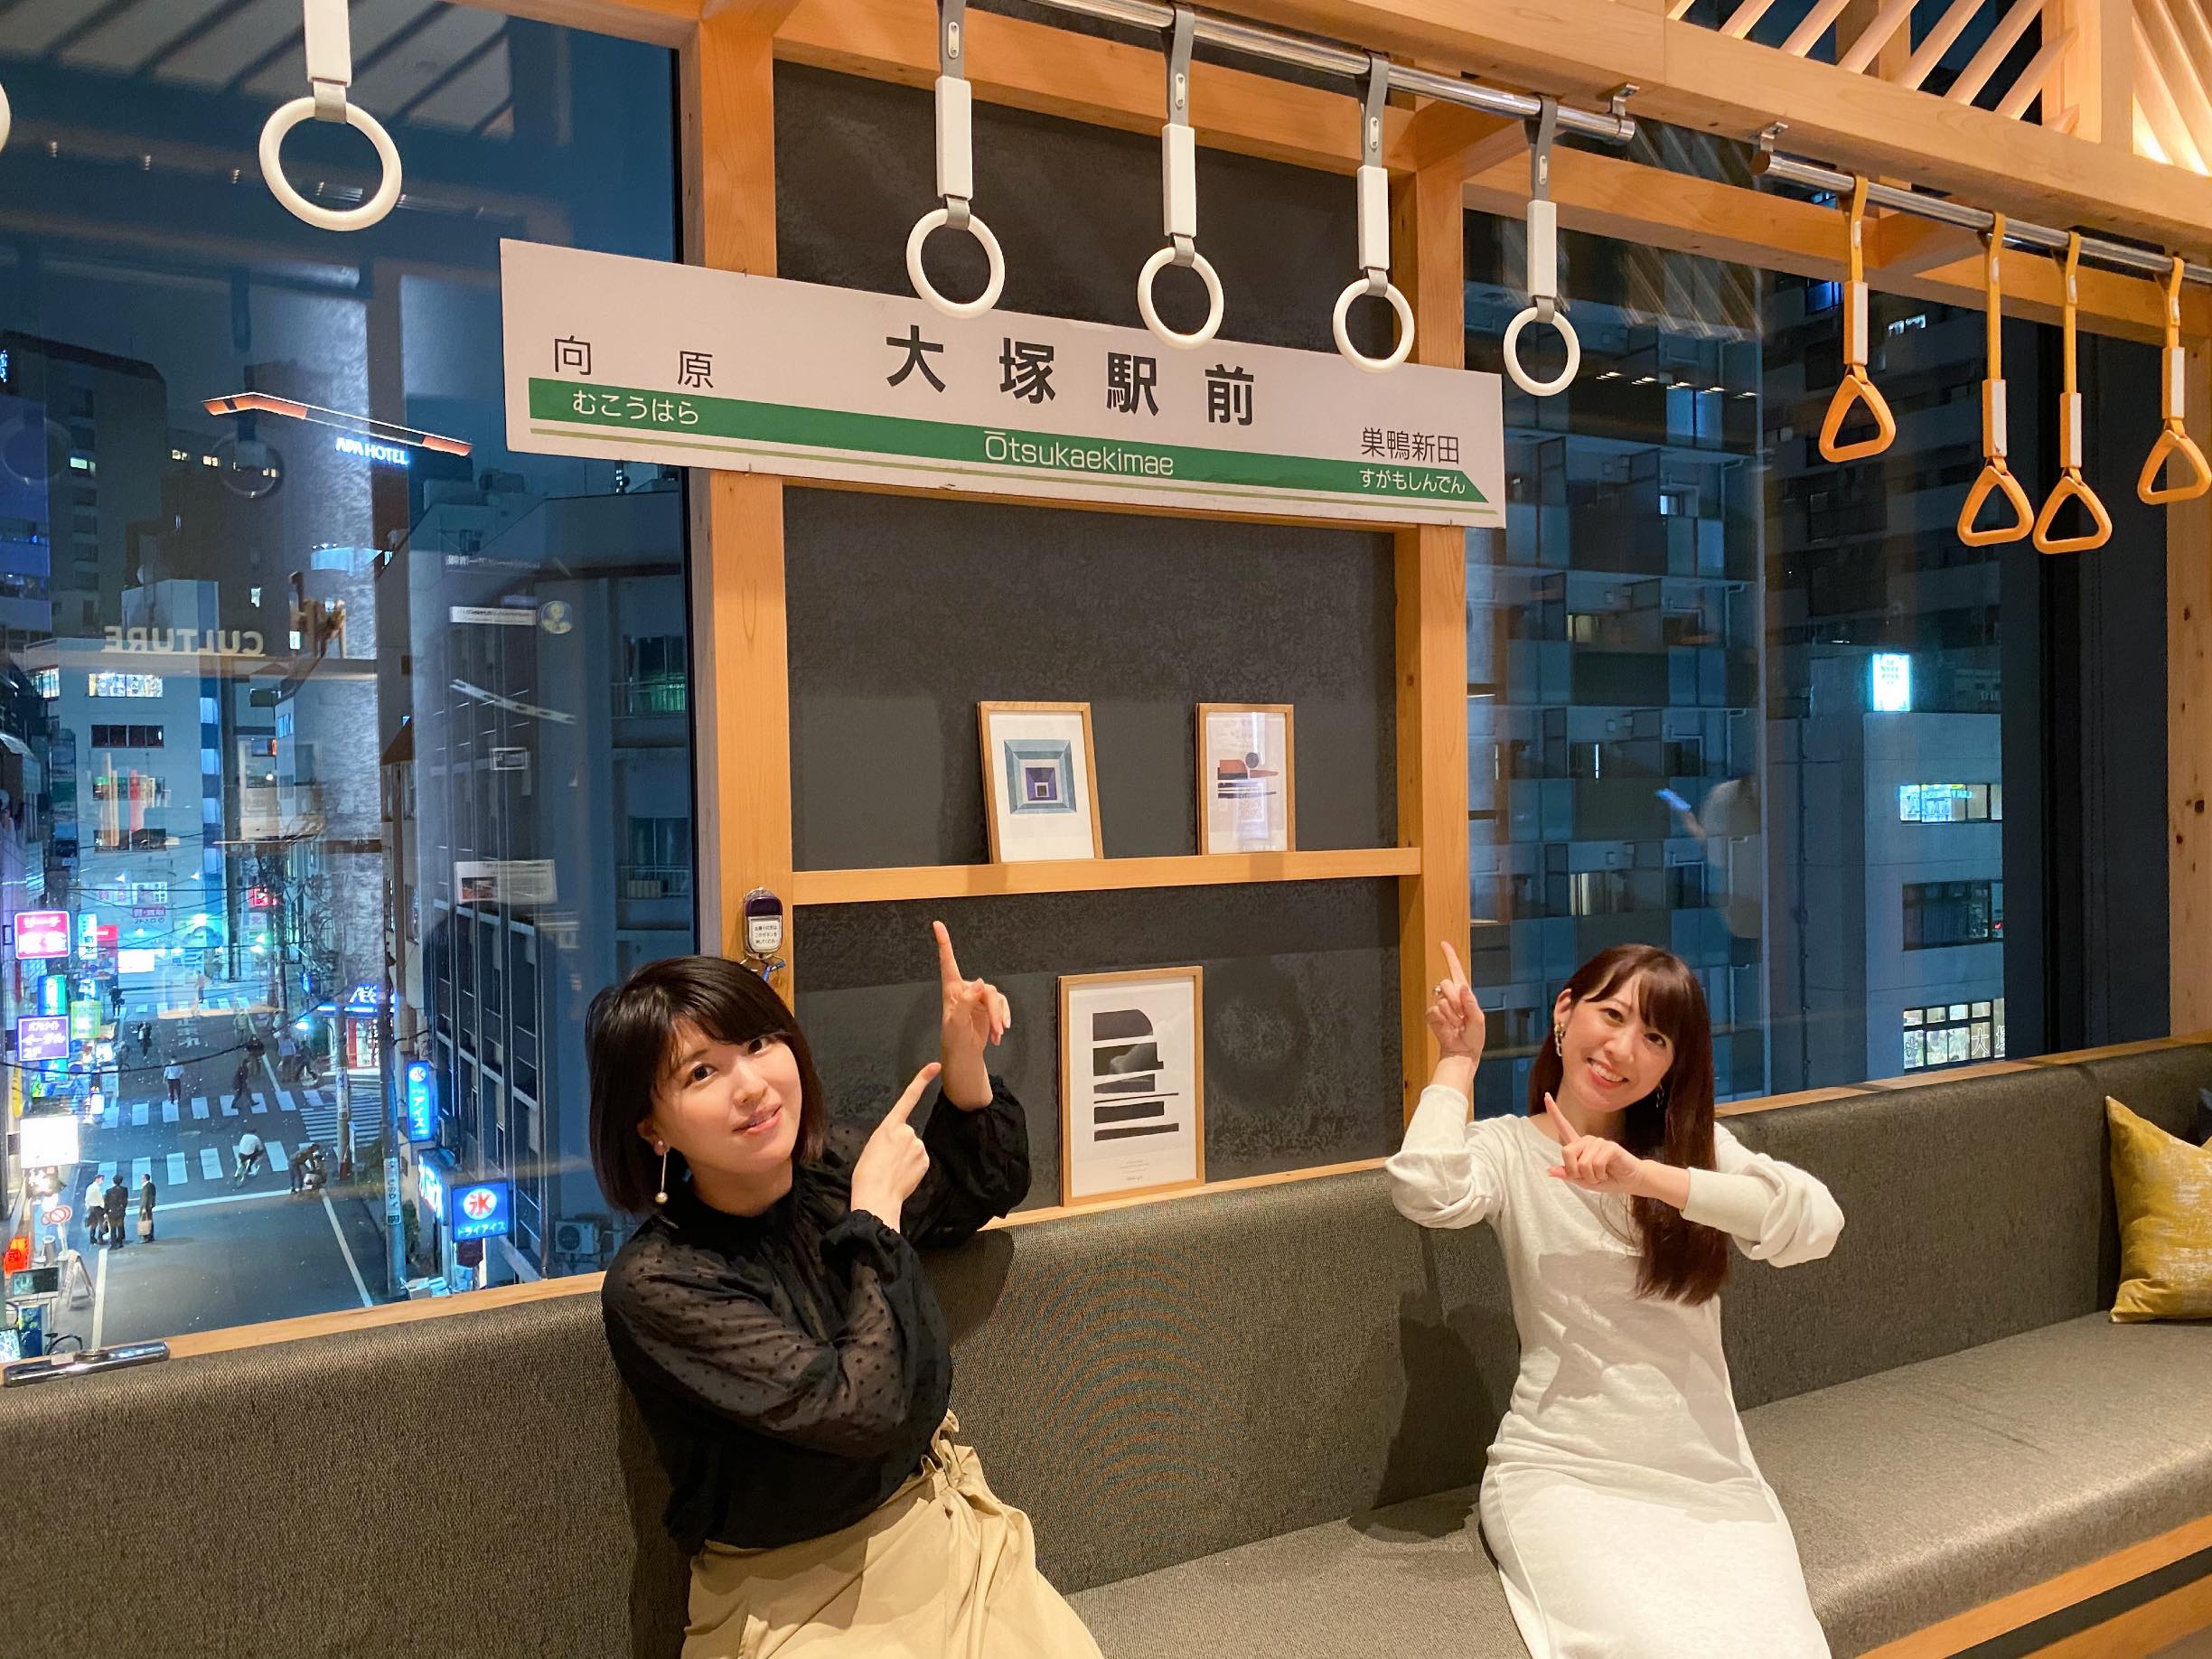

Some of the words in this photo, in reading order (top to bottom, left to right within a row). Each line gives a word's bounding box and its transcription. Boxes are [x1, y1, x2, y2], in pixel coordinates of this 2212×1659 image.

[553, 334, 715, 389] 向原
[886, 323, 1255, 426] 大塚駅前
[572, 389, 699, 426] むこうはら
[335, 436, 364, 456] APA
[364, 443, 409, 465] HOTEL
[983, 430, 1175, 476] Ōtsukaekimae
[1361, 426, 1460, 464] 巣鴨新田
[1358, 468, 1467, 495] すがもしんでん
[468, 1191, 493, 1216] 氷
[456, 1221, 506, 1238] ドライアイス
